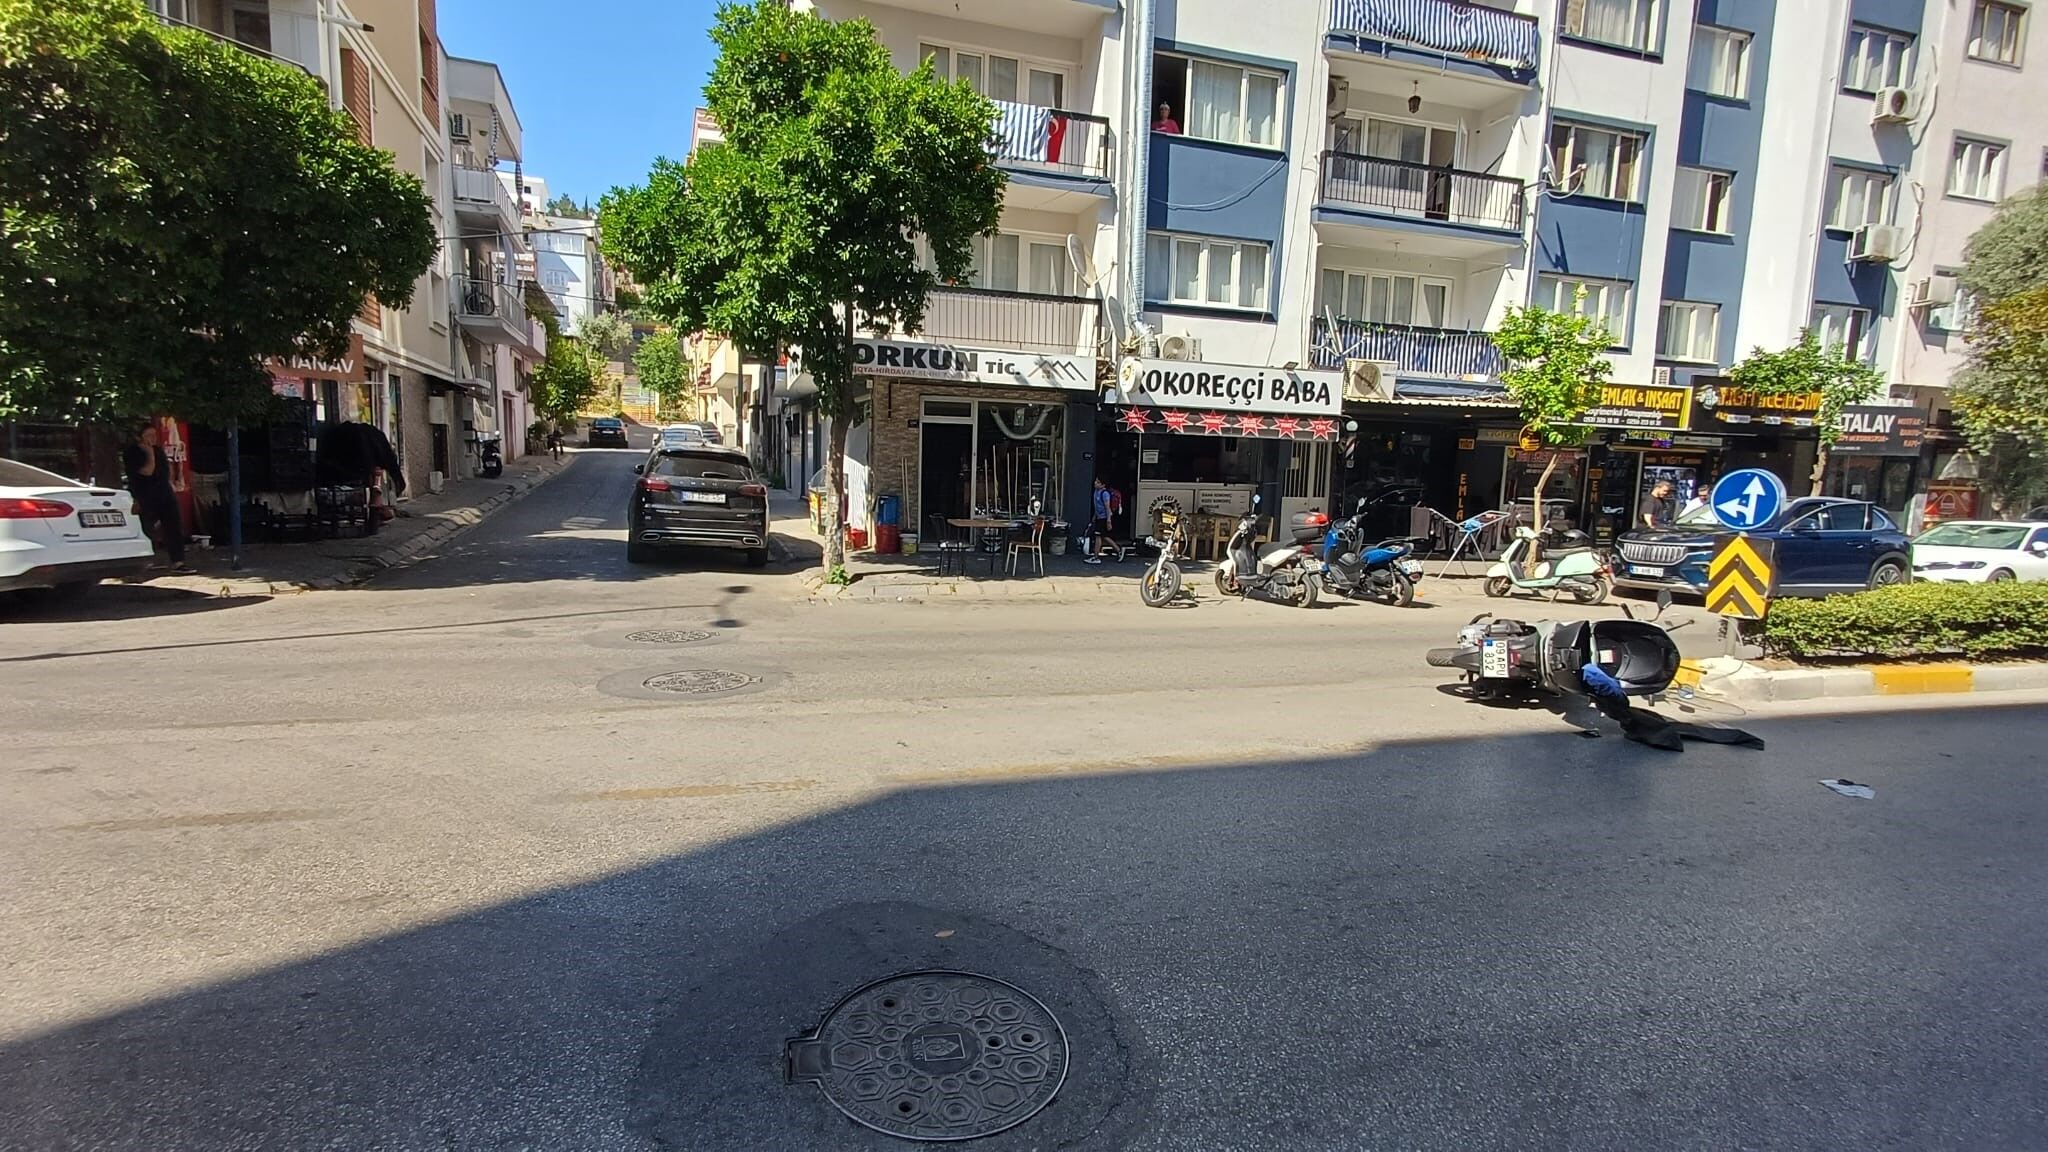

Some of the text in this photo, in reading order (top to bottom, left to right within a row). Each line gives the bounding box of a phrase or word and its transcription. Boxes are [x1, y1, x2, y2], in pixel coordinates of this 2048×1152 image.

[1270, 378, 1331, 406] BABA
[1600, 387, 1637, 406] EMLAK
[1637, 392, 1645, 403] &
[1495, 642, 1506, 676] 09 APU
